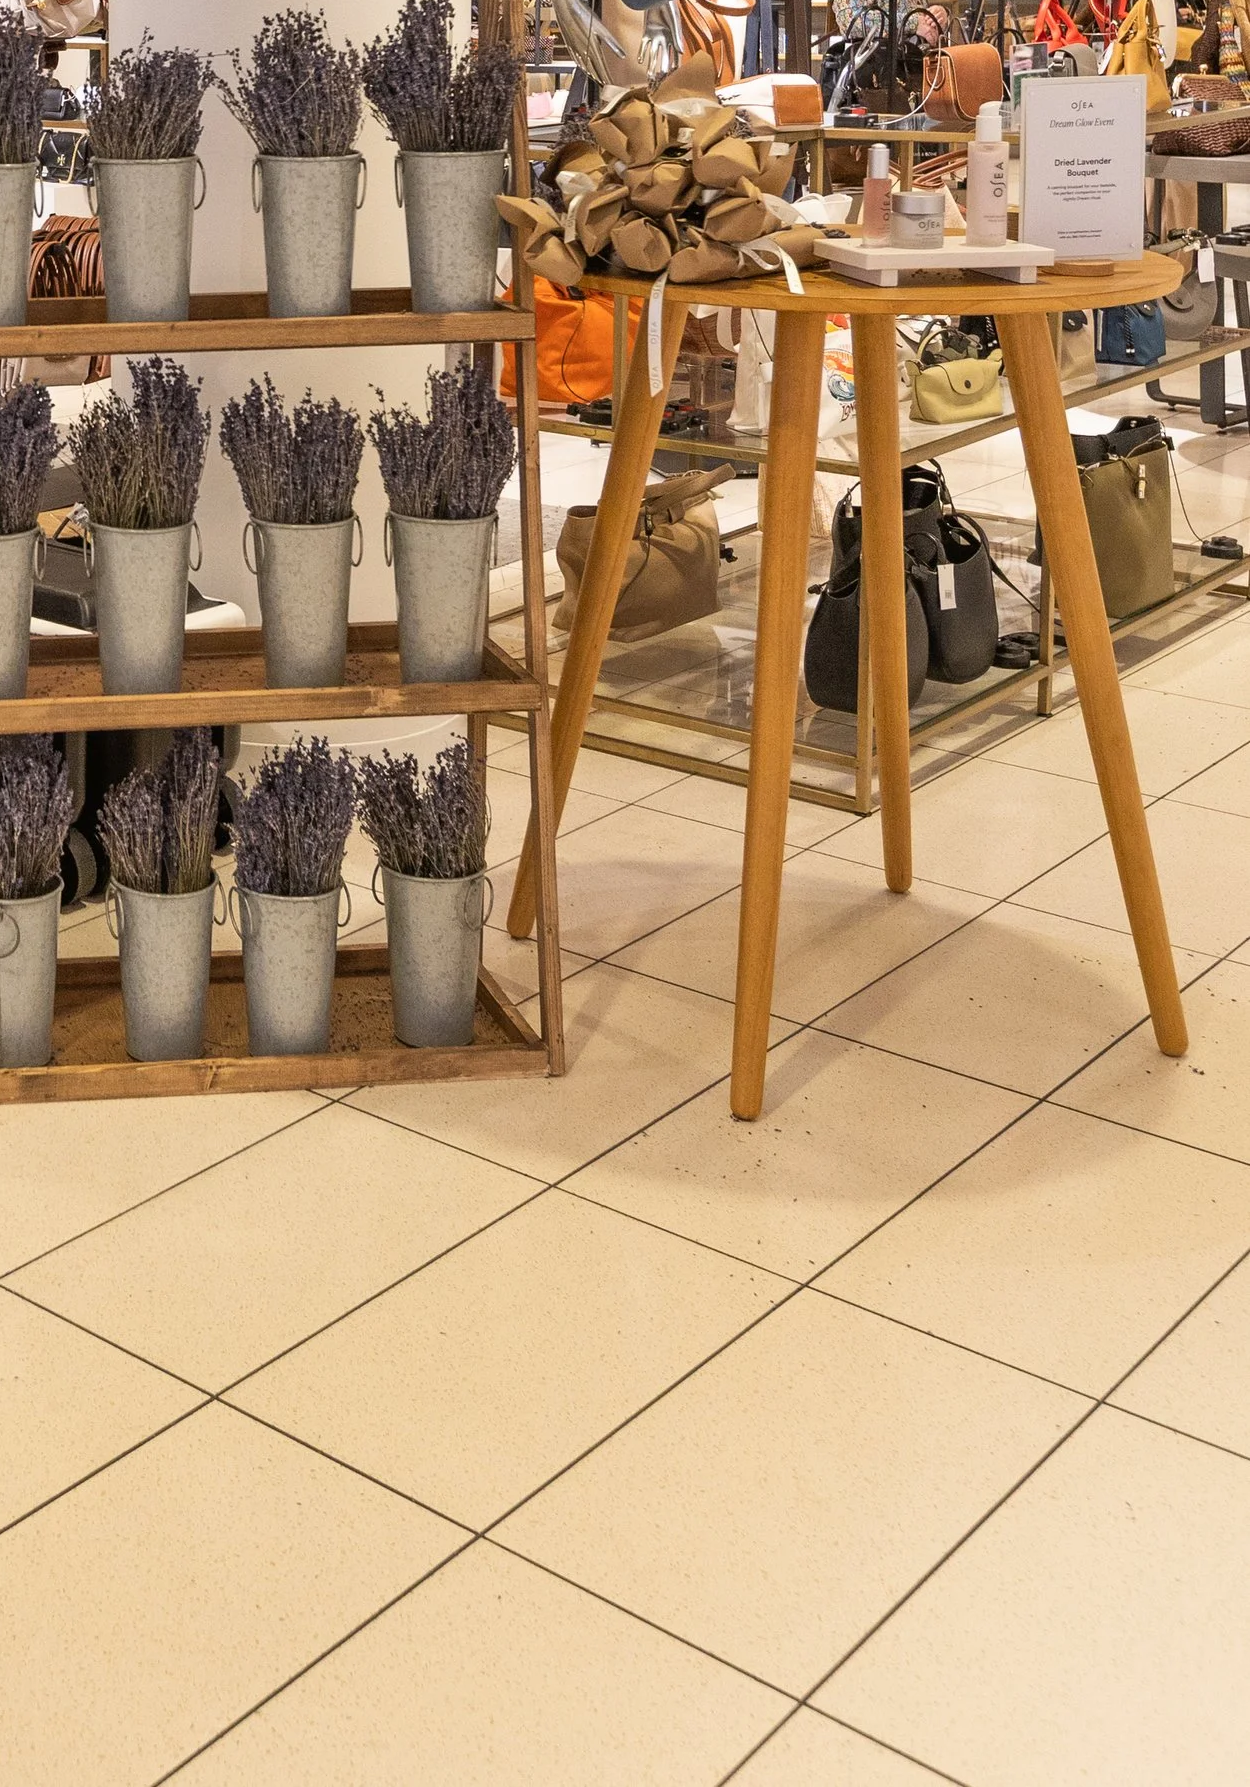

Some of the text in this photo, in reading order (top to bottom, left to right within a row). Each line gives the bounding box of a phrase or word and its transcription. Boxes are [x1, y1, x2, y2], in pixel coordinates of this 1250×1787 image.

[1071, 99, 1094, 111] OSEA
[1049, 117, 1115, 128] Dream Glow Event
[1054, 157, 1112, 167] Dried Lavender
[1066, 168, 1099, 177] Bouquet
[990, 161, 1007, 198] OSEA
[880, 192, 892, 221] OSEA
[918, 219, 941, 231] OSEA
